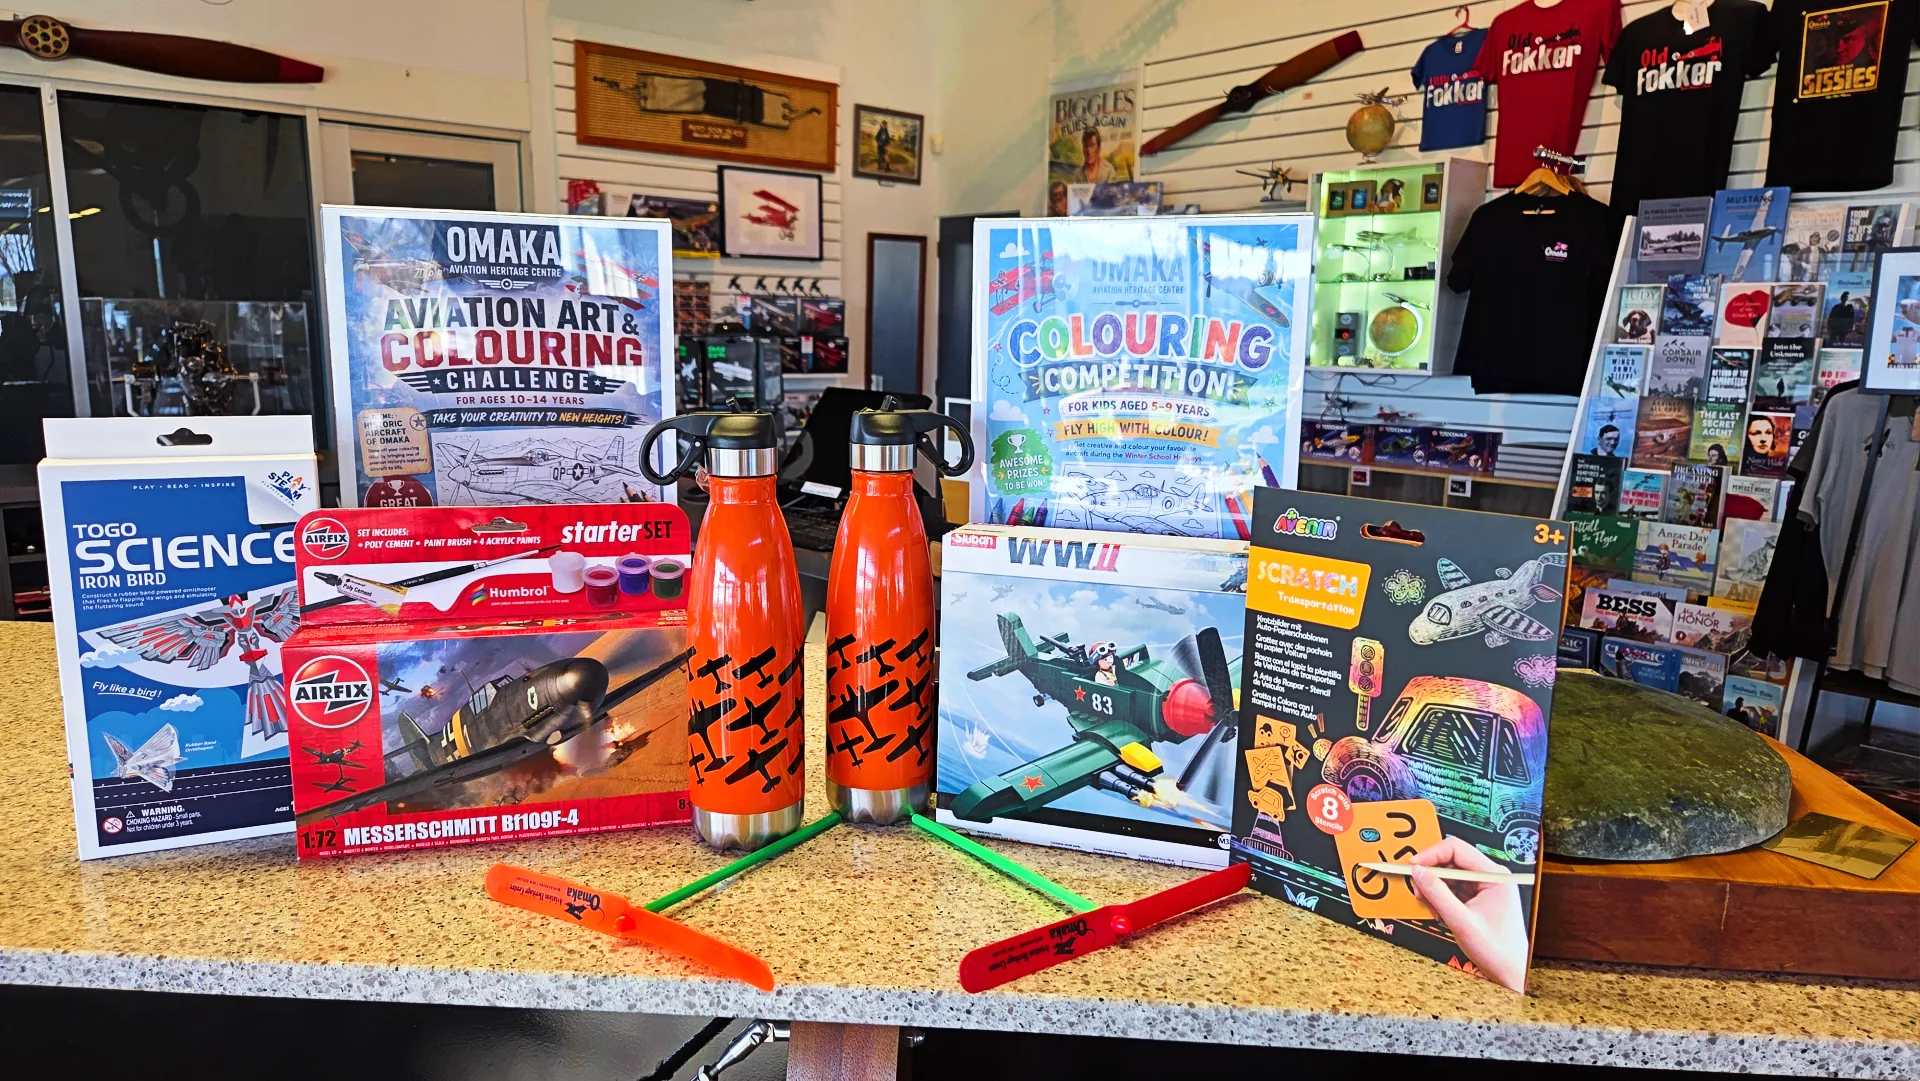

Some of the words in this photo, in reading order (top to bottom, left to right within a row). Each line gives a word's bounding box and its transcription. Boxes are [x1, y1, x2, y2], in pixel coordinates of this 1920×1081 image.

[1508, 33, 1532, 49] Old
[1502, 43, 1582, 76] Fokker
[1641, 46, 1668, 67] Old
[1637, 60, 1722, 96] Fokker
[1803, 66, 1877, 95] SISSIES
[1426, 79, 1485, 108] Fokker
[1055, 88, 1135, 123] BIGGLES
[1061, 119, 1088, 136] FLIES
[1094, 115, 1127, 129] AGAIN
[446, 226, 561, 266] OMAKA
[449, 265, 488, 275] AVIATION
[490, 266, 529, 277] HERITAGE
[531, 268, 562, 278] CENTRE
[1092, 253, 1185, 283] OMAKA
[1092, 285, 1123, 294] AVIATION
[1123, 285, 1157, 294] HERITAGE
[1158, 285, 1185, 294] CENTRE
[1625, 289, 1658, 301] JUDY
[384, 296, 546, 331] AVIATION
[556, 299, 619, 334] ART
[621, 312, 640, 336] &
[1008, 312, 1274, 371] COLOURING
[380, 329, 643, 372] COLOURING
[1662, 348, 1702, 357] CORSAIR
[446, 371, 589, 391] CHALLENGE
[1044, 363, 1235, 401] COMPETITION!
[456, 396, 476, 405] FOR
[480, 396, 506, 405] AGES
[552, 396, 585, 405] YEARS
[1068, 401, 1089, 412] FOR
[1092, 400, 1117, 411] KIDS
[1120, 400, 1148, 411] AGED
[1175, 403, 1210, 417] YEARS
[432, 413, 457, 424] TAKE
[460, 412, 486, 424] YOUR
[489, 411, 544, 423] CREATIVITY
[545, 412, 557, 422] TO
[559, 412, 580, 423] NEW
[582, 412, 627, 424] HEIGHTS!
[1699, 410, 1717, 419] THE
[1719, 411, 1740, 420] LAST
[365, 428, 406, 437] AIRCRAFT
[1064, 423, 1083, 436] FLY
[1087, 422, 1115, 434] HIGH
[1119, 422, 1150, 434] WITH
[1155, 425, 1209, 442] COLOUR!
[1702, 420, 1736, 429] SECRET
[1702, 428, 1733, 437] AGENT
[379, 436, 410, 445] OMAKA
[1074, 441, 1086, 449] Get
[1087, 441, 1113, 450] creative
[1128, 443, 1150, 451] colour
[1150, 445, 1166, 453] your
[999, 454, 1044, 469] AWESOME
[1090, 450, 1111, 459] during
[1112, 451, 1123, 459] the
[1124, 451, 1147, 459] Winter
[1148, 453, 1172, 461] School
[281, 470, 307, 491] PLAY
[552, 466, 566, 480] QP
[1007, 467, 1039, 480] PRIZES
[1004, 481, 1015, 490] TO
[1016, 480, 1026, 490] BE
[1027, 478, 1047, 490] WON!
[380, 496, 418, 508] GREAT
[72, 522, 137, 539] TOGO
[304, 533, 348, 543] AIRFIX
[357, 528, 370, 537] SET
[371, 528, 409, 537] INCLUDES:
[560, 520, 643, 544] starter
[643, 520, 673, 539] SET
[1533, 524, 1566, 546] 3+
[1657, 528, 1687, 540] Anzac
[1688, 531, 1709, 544] Day
[364, 540, 384, 549] POLY
[385, 539, 414, 548] CEMENT
[423, 538, 446, 547] PAINT
[447, 537, 471, 547] BRUSH
[485, 536, 513, 546] ACRYLIC
[514, 535, 542, 545] PAINTS
[954, 533, 994, 546] Sluban
[1671, 539, 1704, 551] Parade
[75, 530, 295, 575] SCIENCE
[79, 573, 121, 590] IRON
[126, 572, 167, 588] BIRD
[1257, 560, 1358, 597] SCRATCH
[342, 583, 354, 592] Poly
[354, 586, 373, 597] Cement
[489, 585, 548, 598] Humbrol
[1277, 591, 1355, 615] Transportation
[1595, 593, 1657, 617] BESS
[1677, 613, 1720, 629] HONOR
[92, 681, 107, 692] Fly
[109, 683, 127, 693] like
[137, 687, 155, 697] bird
[294, 682, 370, 701] AIRFIX
[1091, 692, 1114, 716] 83
[1310, 787, 1337, 801] Scratch
[1337, 789, 1351, 811] with
[1321, 796, 1339, 820] 8
[126, 816, 151, 826] CHOKING
[151, 814, 173, 823] HAZARD
[142, 823, 162, 831] children
[343, 814, 498, 847] MESSERSCHMITT
[501, 808, 579, 832] Bf109F-4
[1314, 816, 1344, 832] Stencils
[301, 829, 337, 849] 1:72
[509, 884, 525, 896] Centre
[524, 887, 545, 901] Heritage
[544, 892, 564, 906] Aviation
[566, 886, 601, 911] Omaka
[1049, 918, 1088, 941] Omaka
